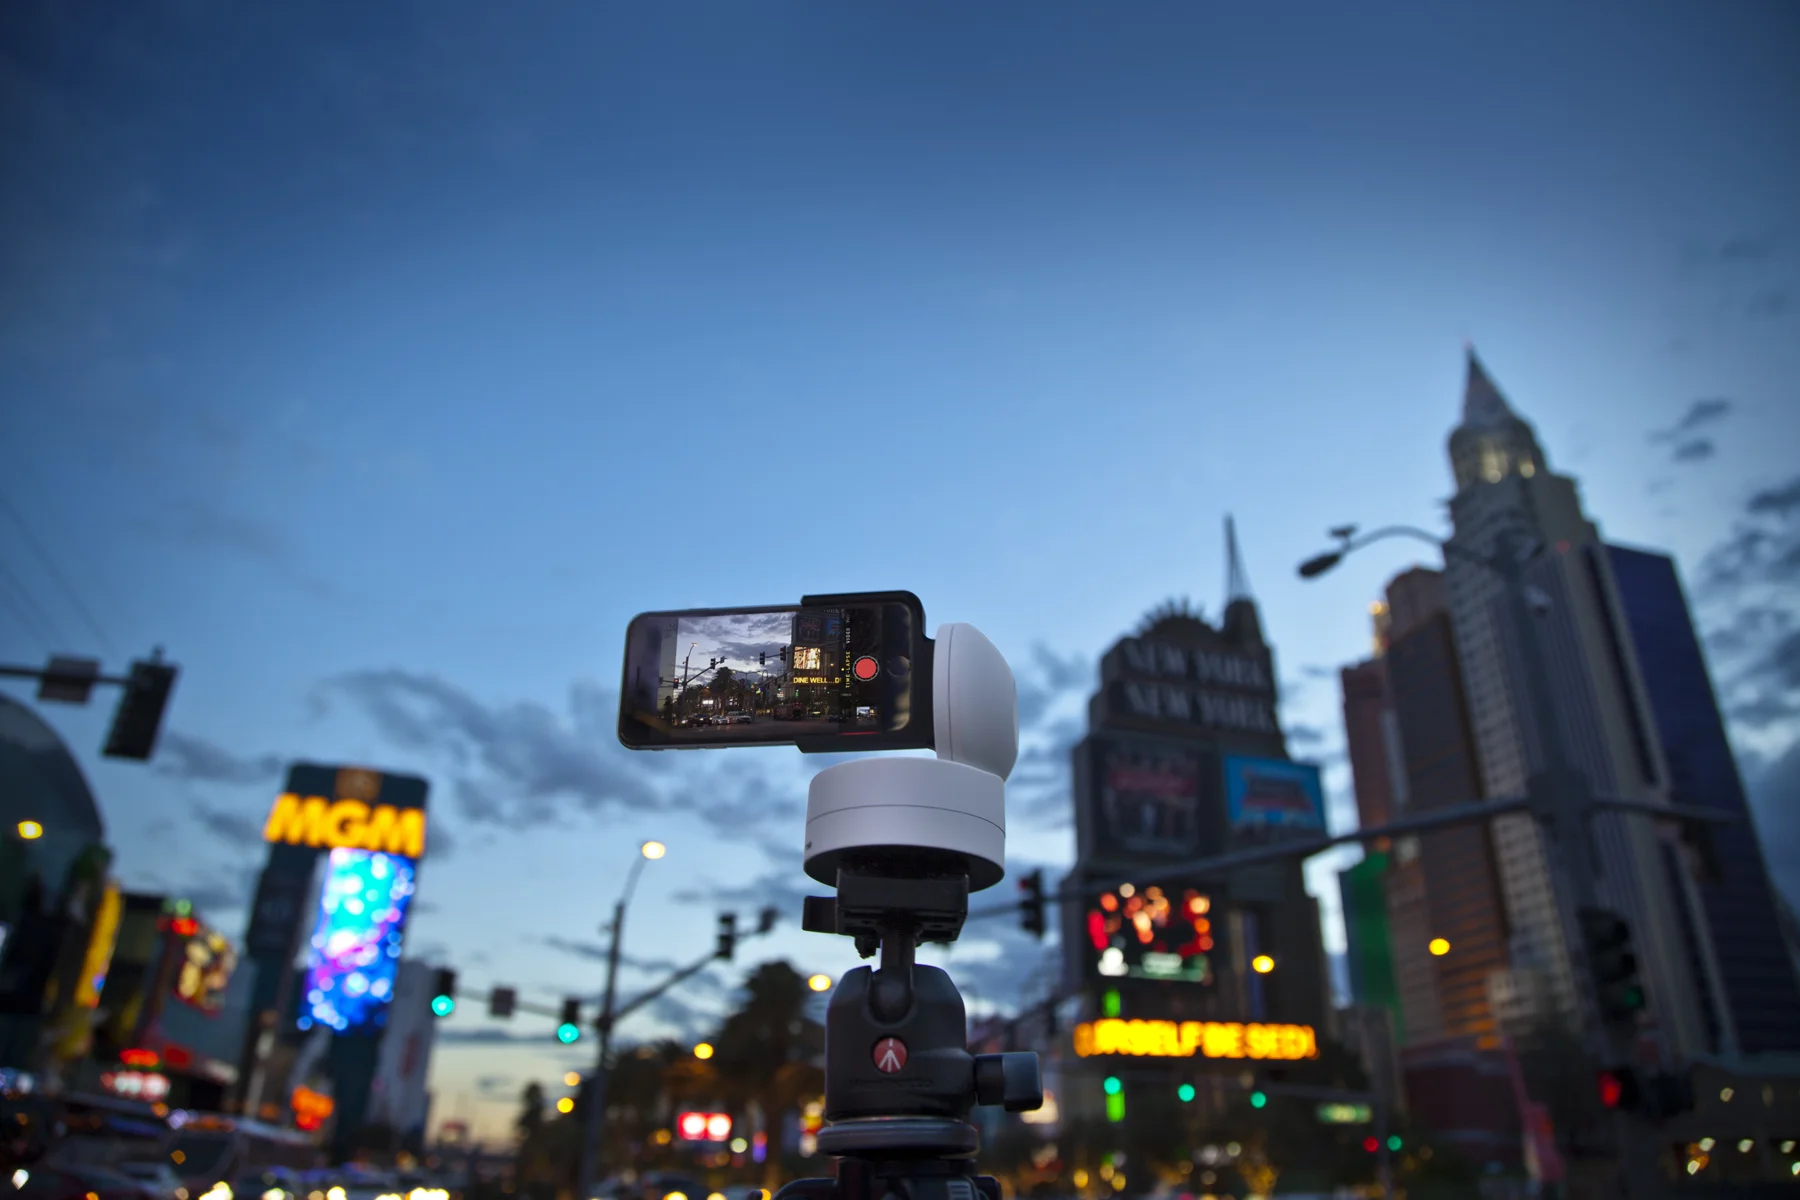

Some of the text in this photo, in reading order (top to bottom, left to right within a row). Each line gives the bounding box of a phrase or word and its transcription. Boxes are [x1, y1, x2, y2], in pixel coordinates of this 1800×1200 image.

[1125, 642, 1187, 675] NEW
[793, 677, 808, 685] DINE
[1125, 680, 1190, 717] NEW
[263, 792, 426, 858] MGM
